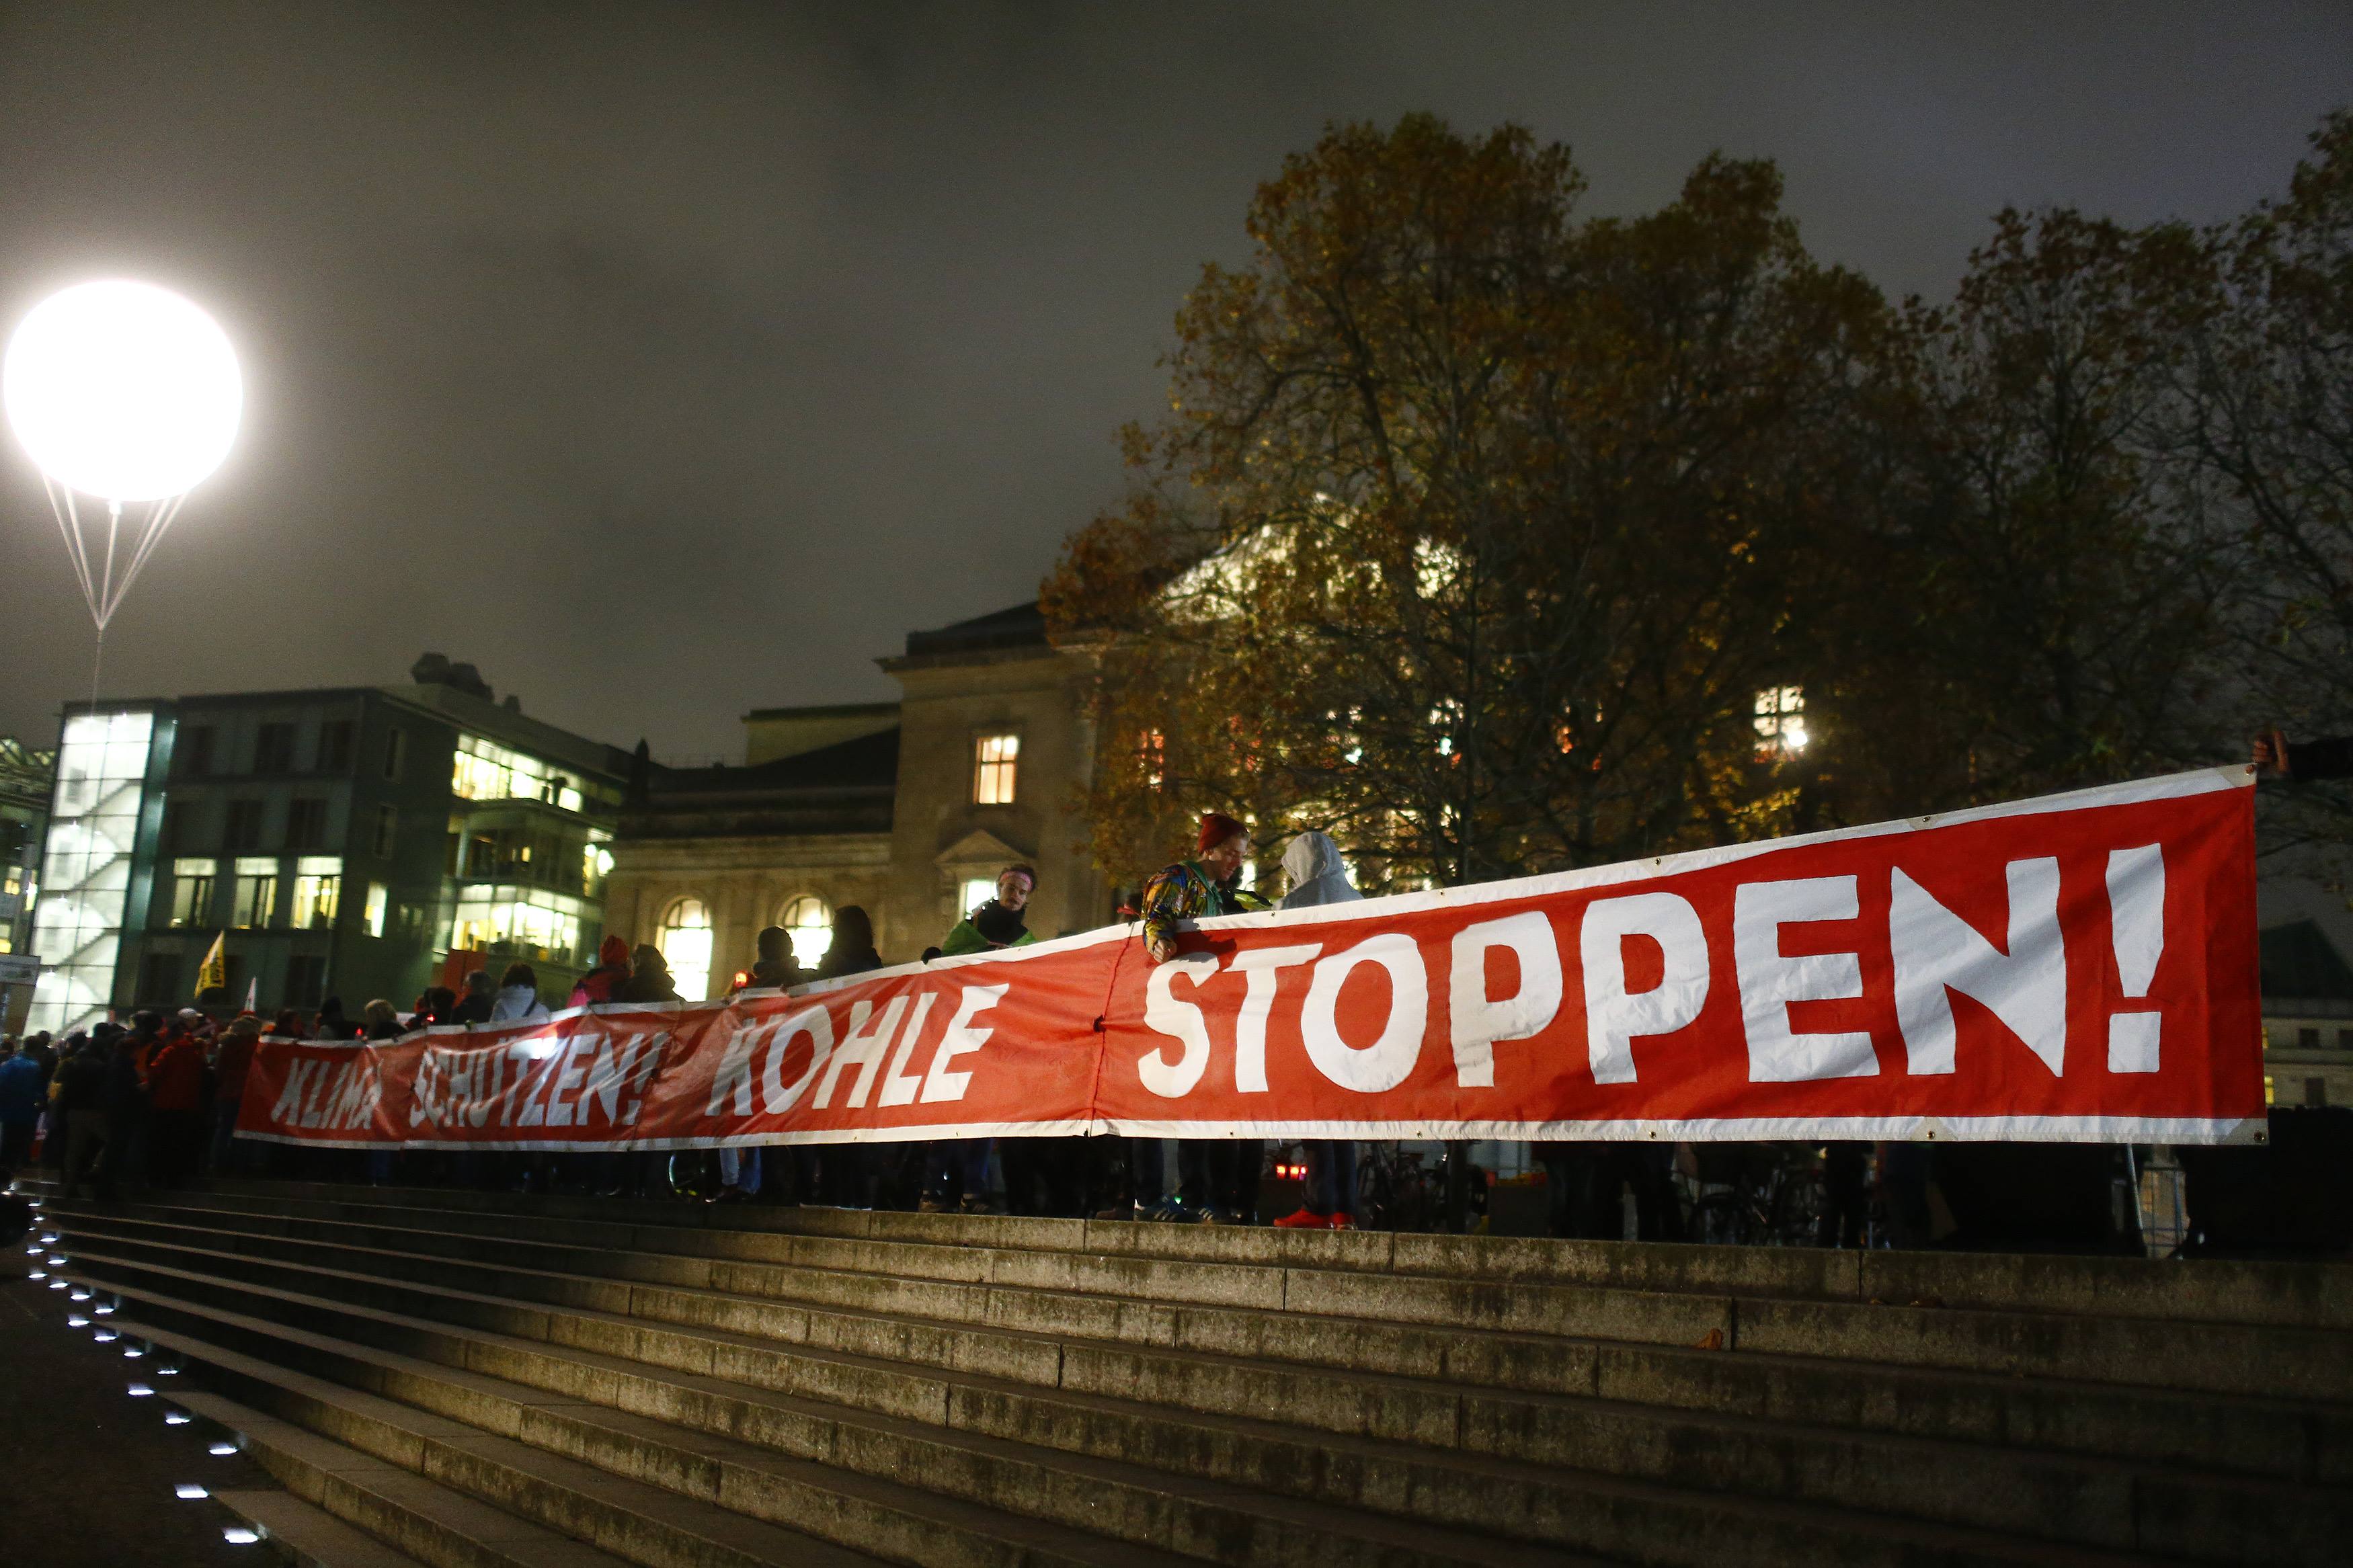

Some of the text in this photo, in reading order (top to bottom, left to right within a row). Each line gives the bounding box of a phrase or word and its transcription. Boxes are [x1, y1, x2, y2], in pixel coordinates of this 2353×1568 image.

[270, 842, 2165, 1130] KLIMA SCHÜTZEN! KOHLE STOPPEN!
